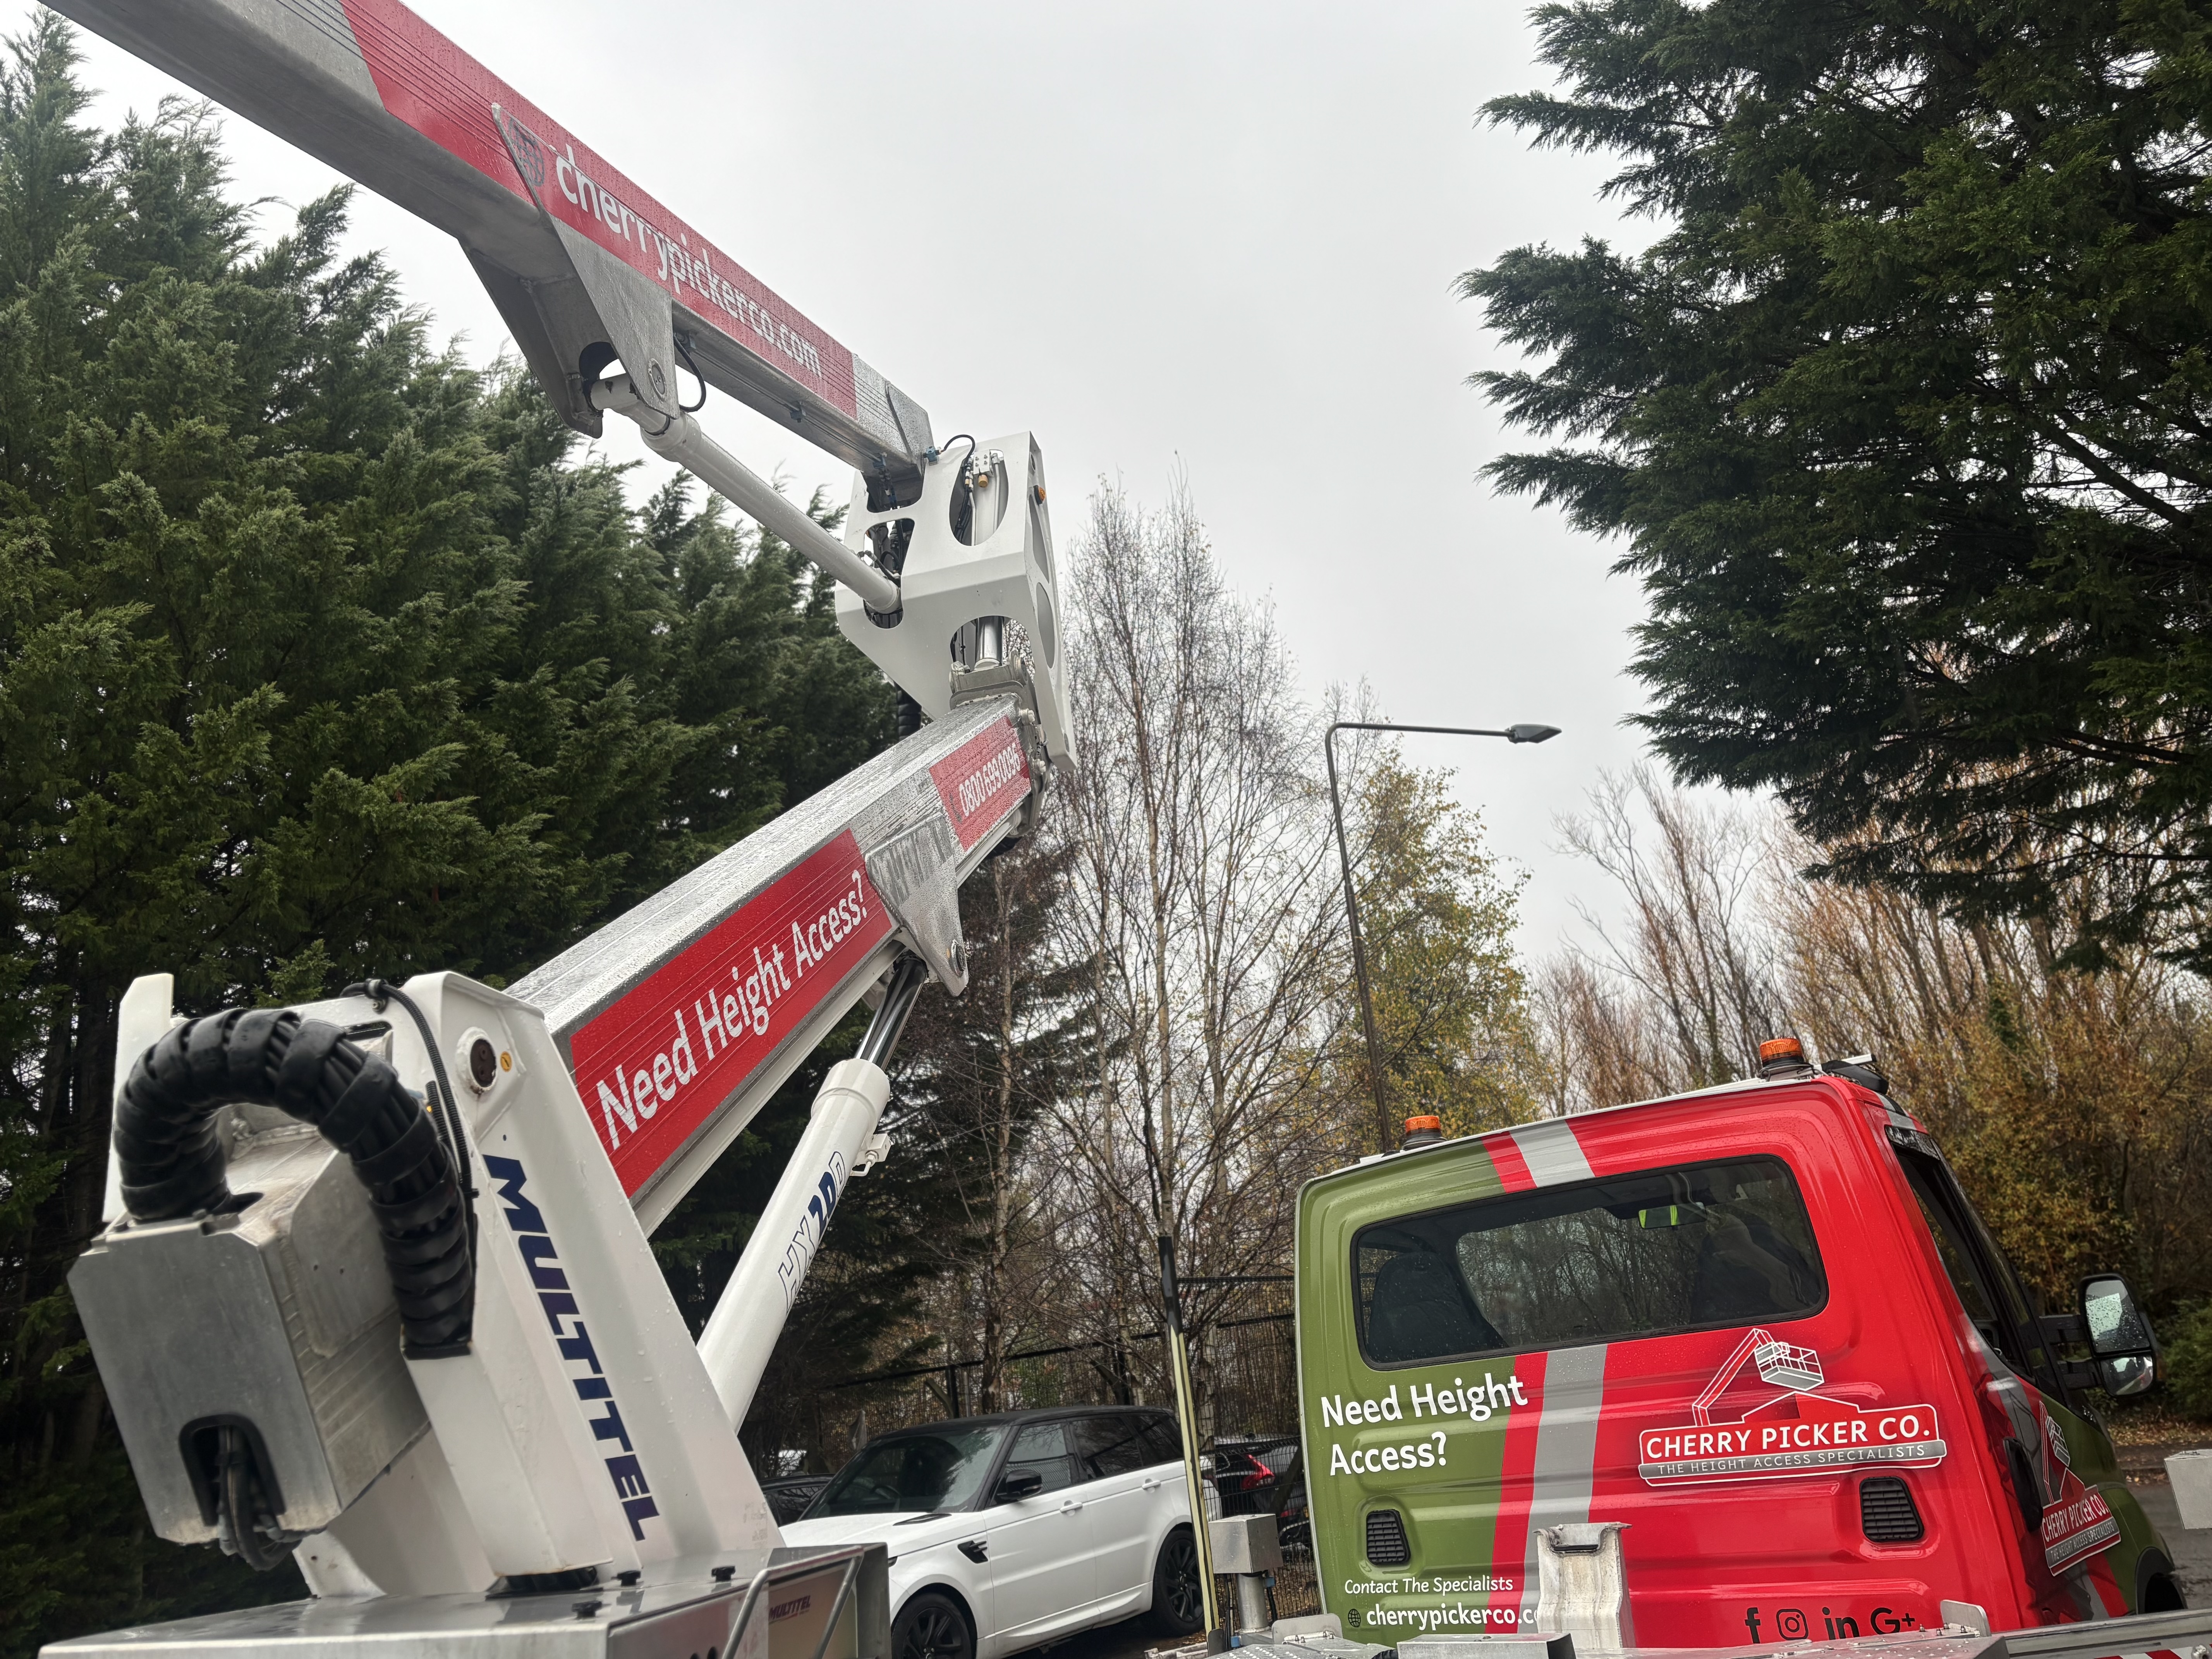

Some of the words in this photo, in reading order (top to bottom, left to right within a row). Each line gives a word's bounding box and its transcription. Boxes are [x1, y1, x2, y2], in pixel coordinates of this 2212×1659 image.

[556, 144, 822, 378] cherrypickerco.com
[959, 770, 986, 817] 0800
[596, 1008, 698, 1151] Need
[695, 943, 791, 1061] Height
[792, 869, 867, 979] Access?
[483, 1153, 660, 1542] MULTITEL
[1321, 1384, 1403, 1428] Need
[1410, 1372, 1528, 1422] Height
[1330, 1431, 1447, 1476] Access?
[1646, 1429, 1752, 1459] CHERRY
[1762, 1420, 1868, 1450] PICKER
[1879, 1415, 1930, 1440] CO.
[1657, 1463, 1684, 1475] THE
[1691, 1459, 1747, 1472] HEIGHT
[1753, 1454, 1811, 1468] ACCESS
[1818, 1444, 1925, 1463] SPECIALISTS
[2042, 1508, 2070, 1542] CHERRY
[2068, 1498, 2098, 1529] PICKER
[2090, 1494, 2109, 1517] CO.
[2087, 1521, 2114, 1542] SPECIALISTS
[768, 1595, 811, 1620] MULTITEL
[1345, 1579, 1399, 1594] Contact
[1402, 1577, 1429, 1593] The
[1433, 1575, 1513, 1596] Specialists
